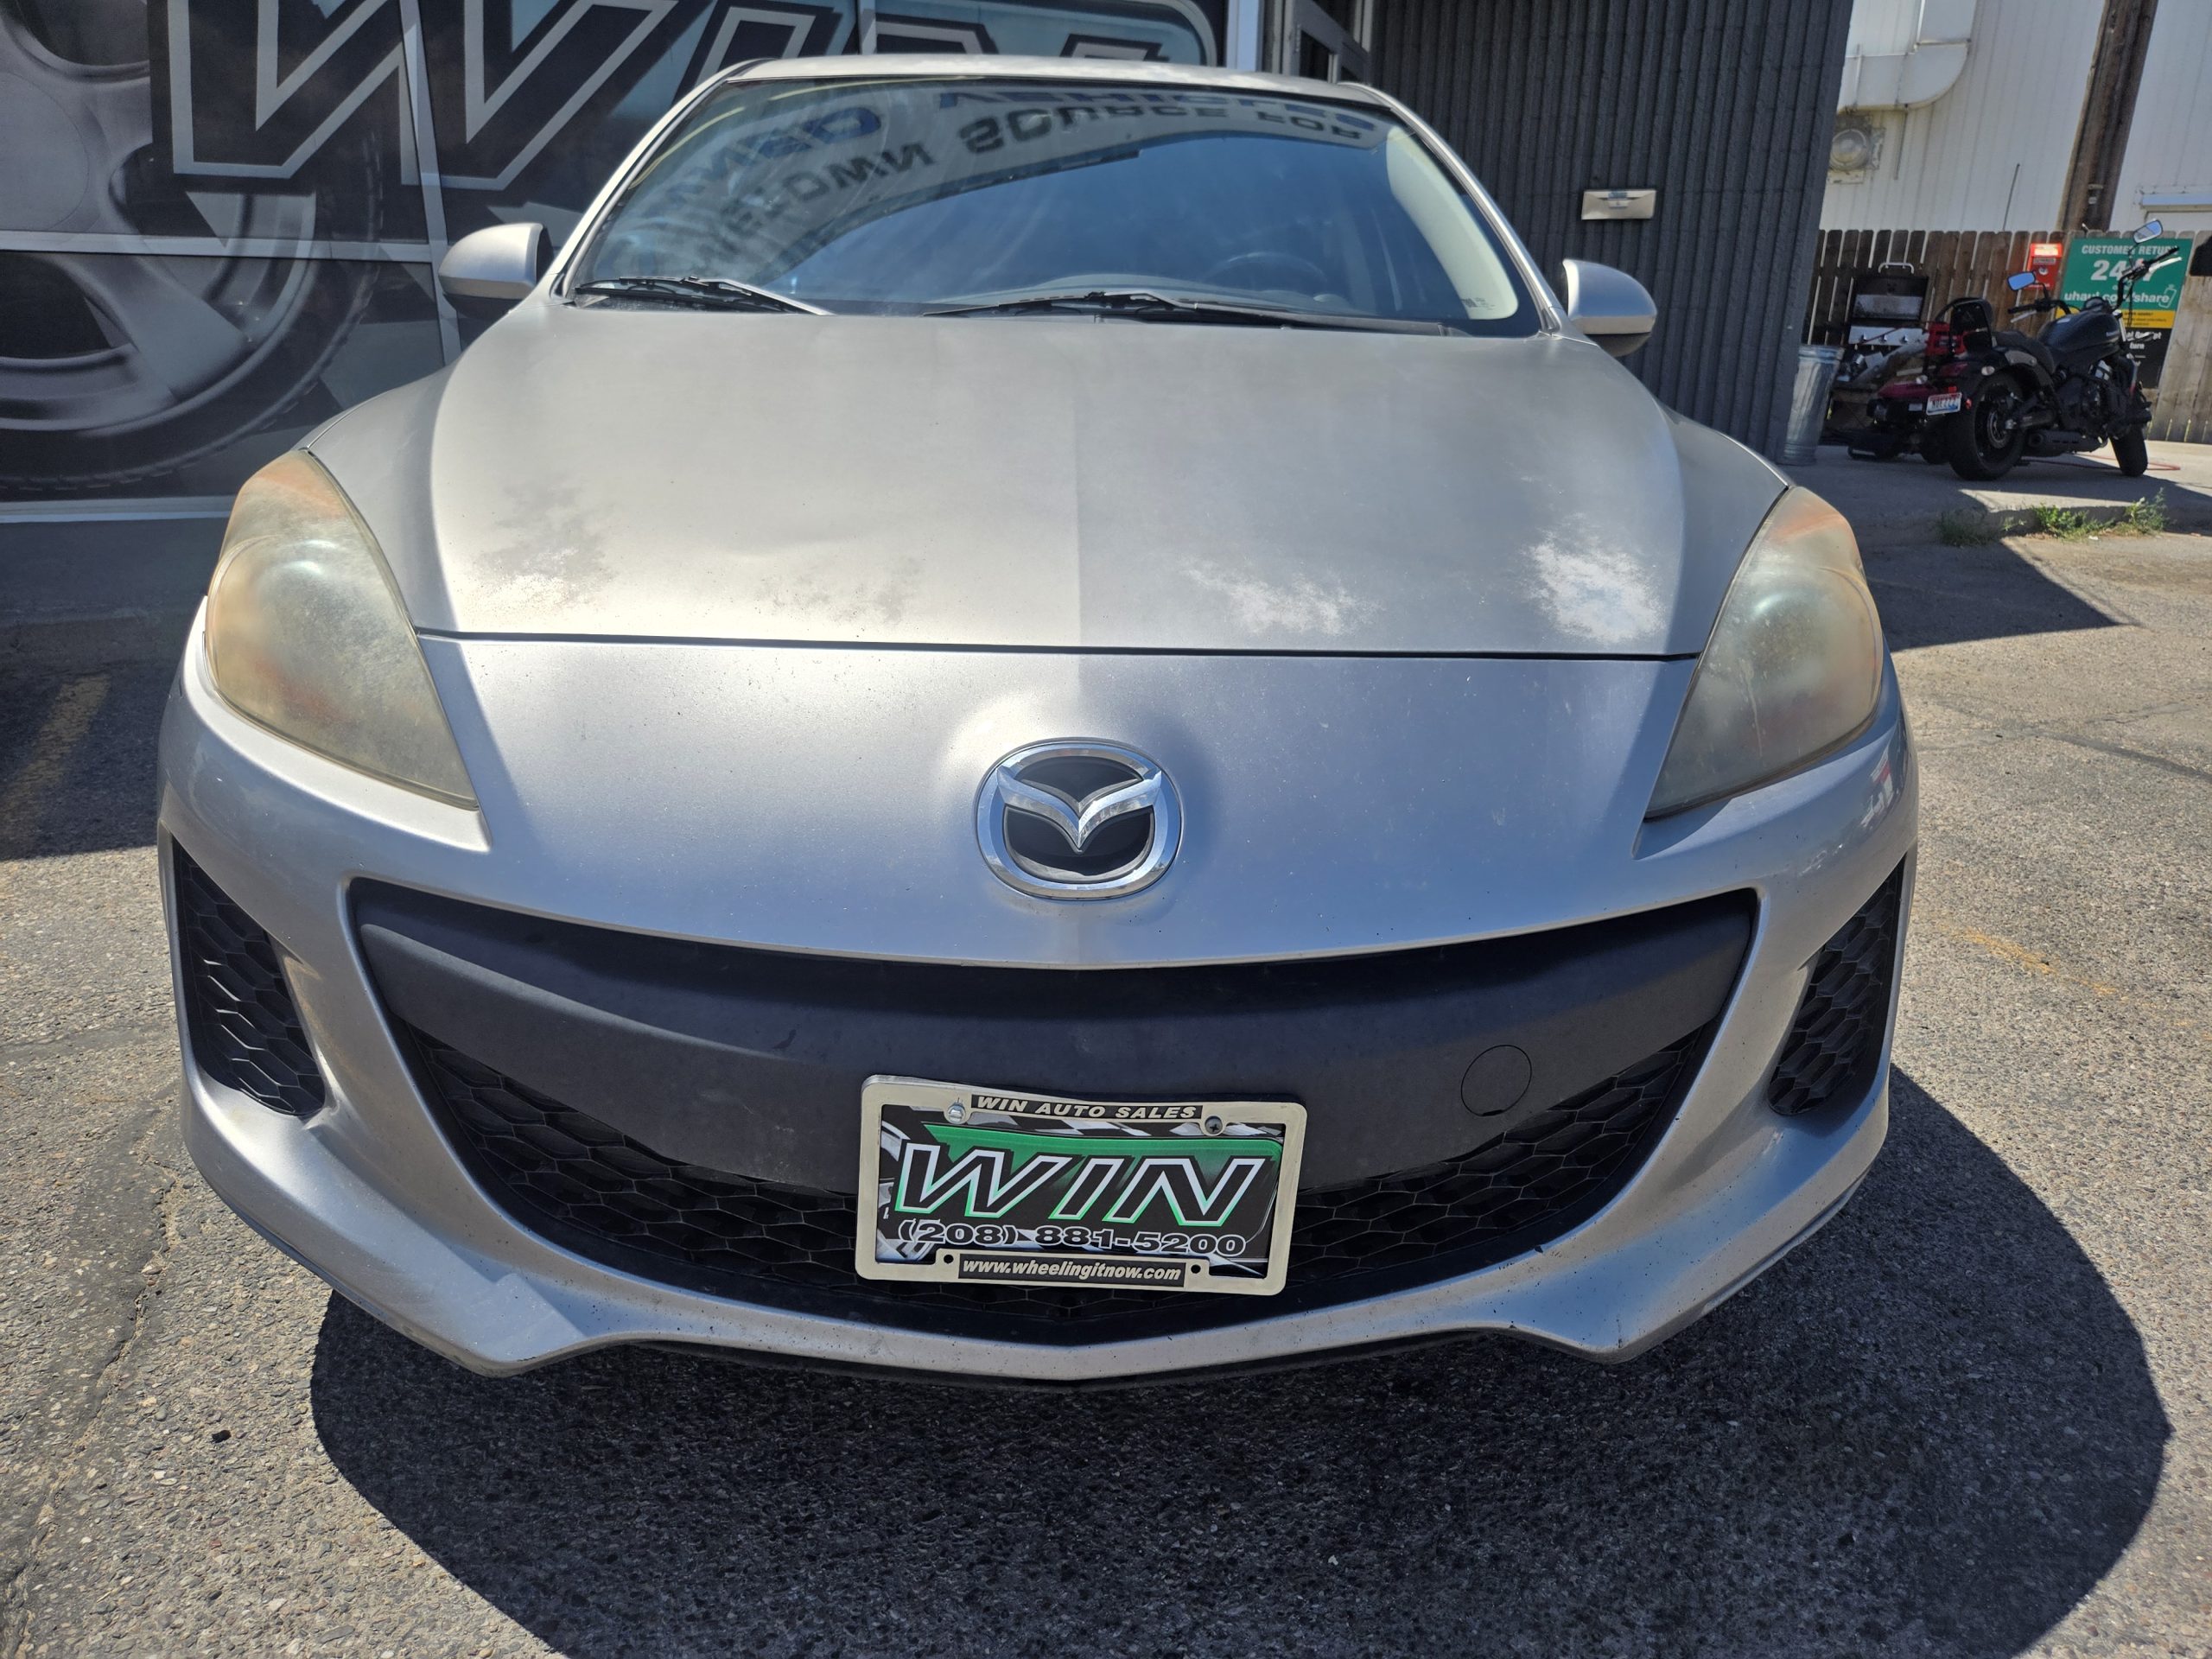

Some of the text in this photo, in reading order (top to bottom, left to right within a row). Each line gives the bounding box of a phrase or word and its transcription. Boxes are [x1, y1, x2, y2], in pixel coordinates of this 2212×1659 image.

[976, 1096, 1198, 1121] WIN AUTO SALES
[894, 1142, 1267, 1227] WIN
[898, 1218, 1247, 1256] (208) 881-5200
[962, 1259, 1182, 1282] www.wheelingitnow.com
